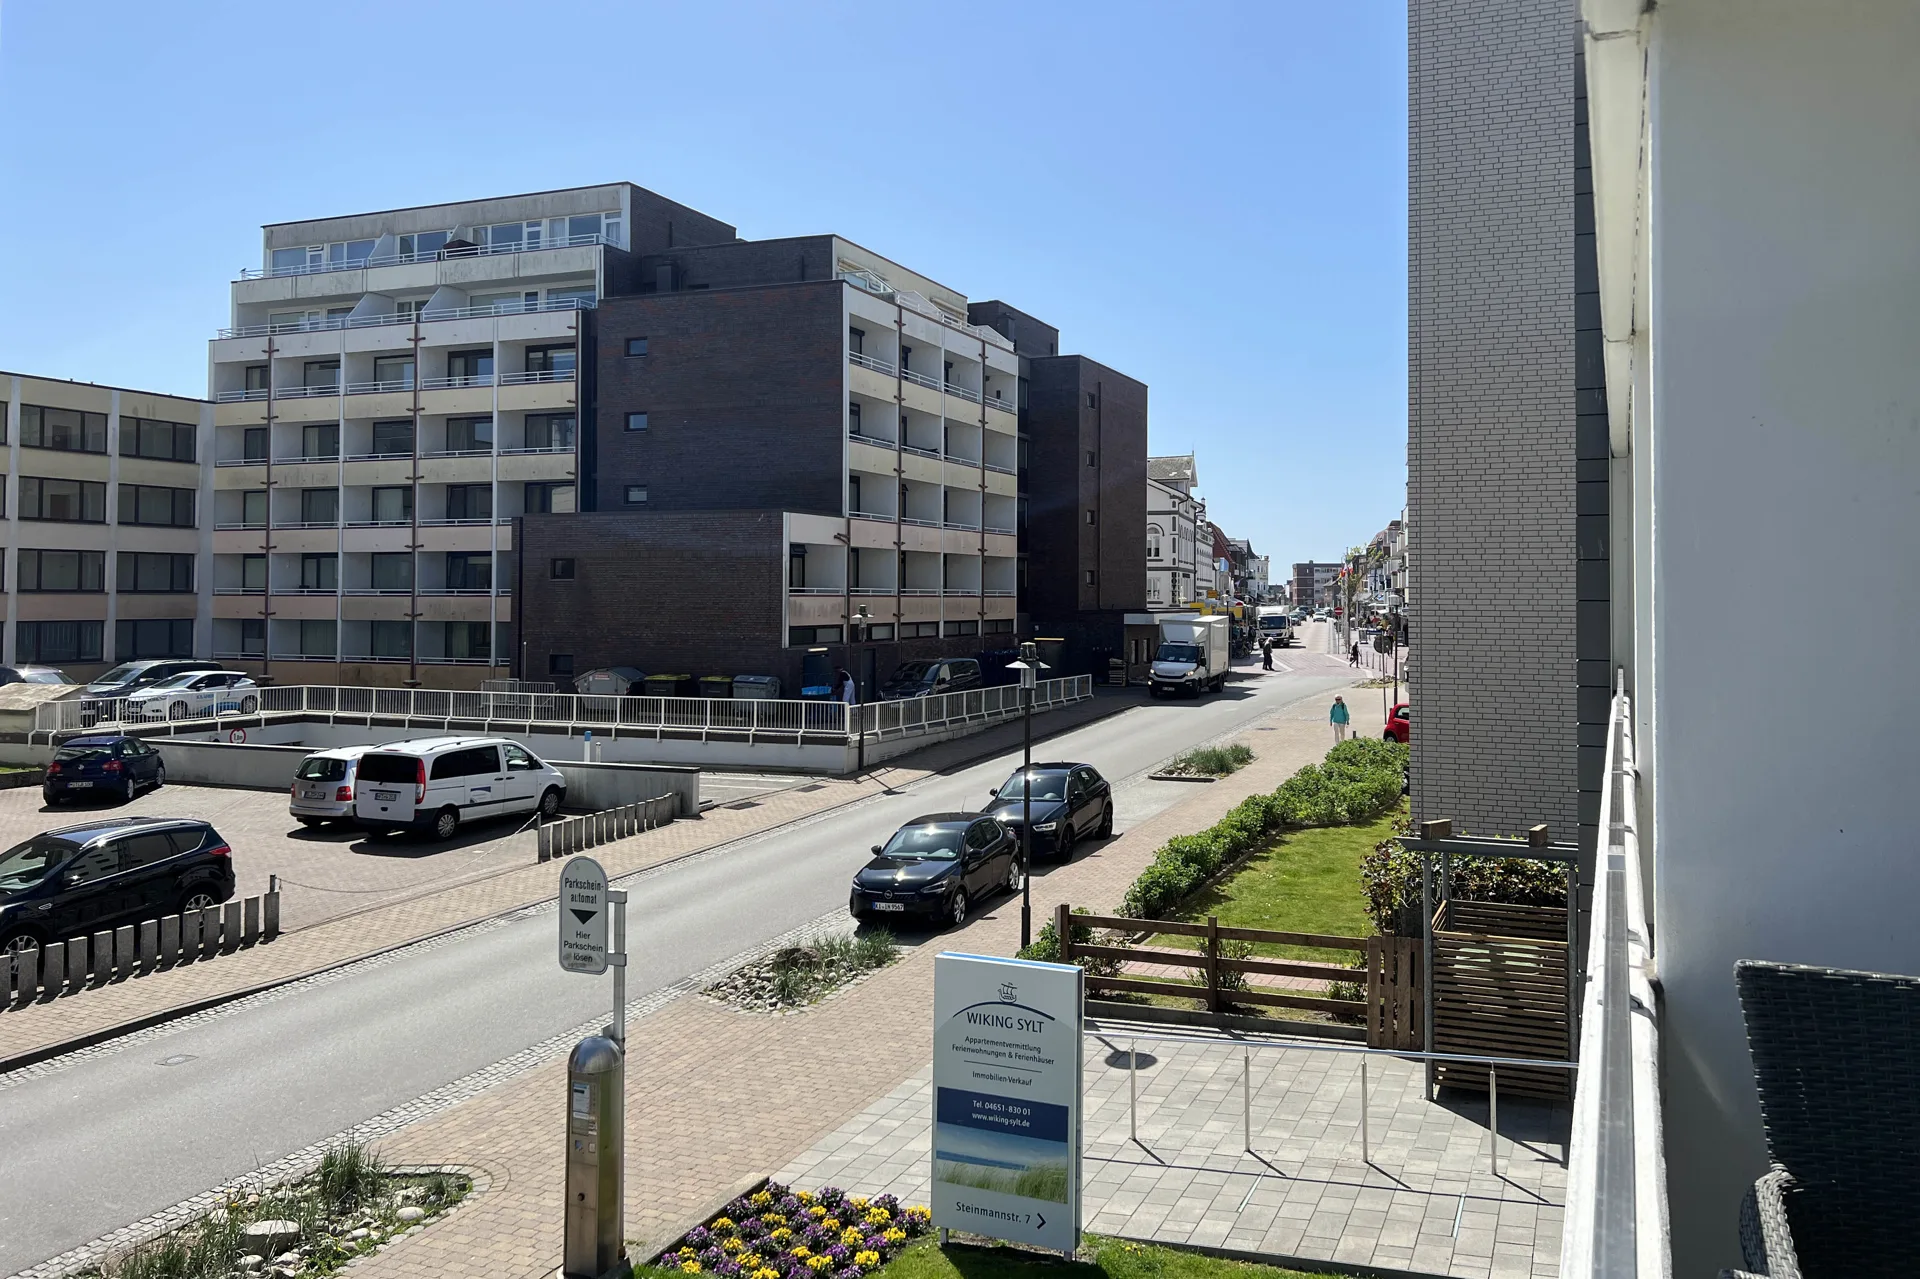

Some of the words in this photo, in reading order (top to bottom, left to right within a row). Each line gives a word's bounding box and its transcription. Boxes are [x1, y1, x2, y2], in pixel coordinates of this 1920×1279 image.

[565, 877, 604, 891] Parkschein-
[576, 931, 591, 939] Hier
[563, 940, 603, 953] Parkschein
[573, 953, 593, 963] lösen
[967, 1012, 1013, 1029] WIKING
[1017, 1018, 1044, 1033] SYLT
[964, 1036, 1042, 1054] Appartementvermittlung
[952, 1044, 1007, 1058] Ferienwohnungen
[1014, 1053, 1055, 1065] Ferienhäuser
[972, 1071, 1033, 1086] Immobilien-Verkauf
[973, 1100, 984, 1109] Tel.
[971, 1112, 1031, 1127] www.wiking-sylt.de
[956, 1201, 1022, 1223] Steinmannstr.
[1025, 1214, 1031, 1224] 7
